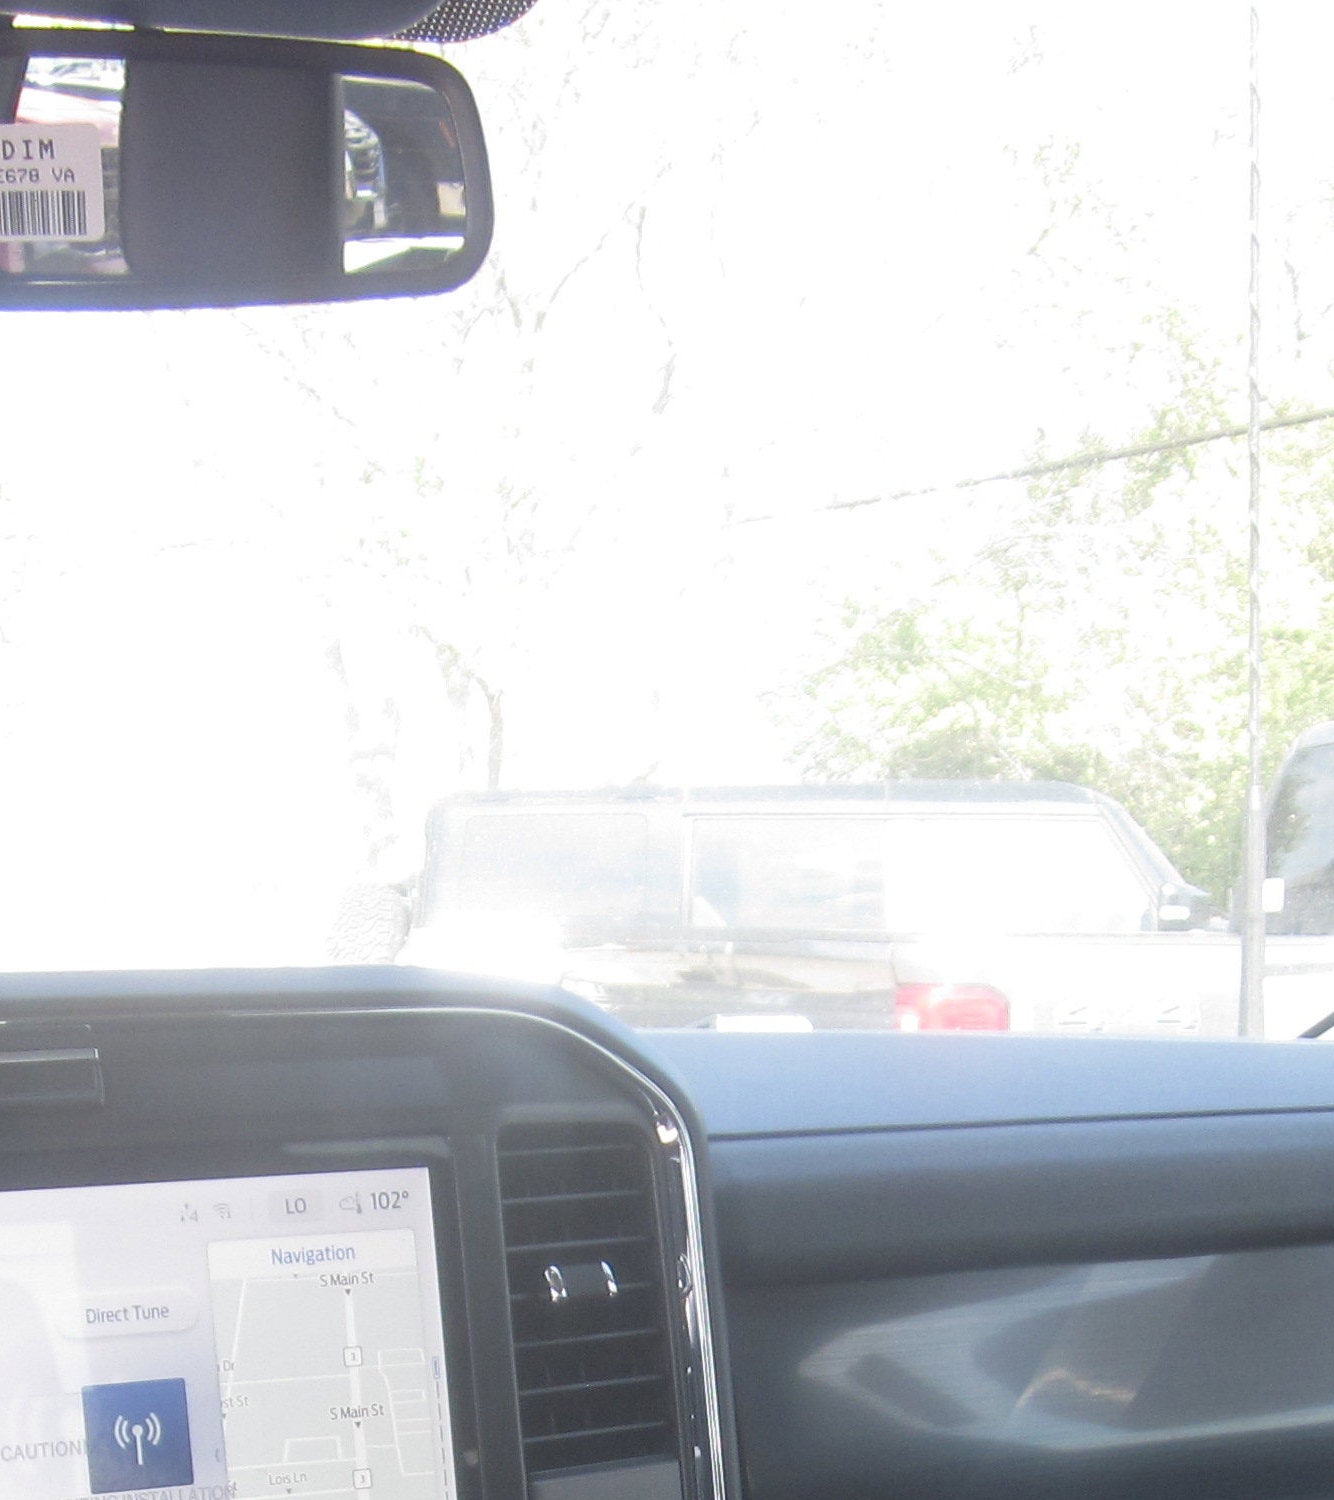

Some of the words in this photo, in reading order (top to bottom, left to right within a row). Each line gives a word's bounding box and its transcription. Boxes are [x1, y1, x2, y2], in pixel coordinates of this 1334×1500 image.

[52, 167, 75, 183] VA
[285, 1197, 307, 1215] LO
[370, 1190, 409, 1211] 102°
[271, 1244, 356, 1267] Navigation
[320, 1275, 328, 1287] S
[330, 1272, 360, 1287] Main
[363, 1271, 375, 1284] St
[86, 1306, 129, 1325] Direct
[134, 1304, 169, 1322] Tune
[329, 1408, 338, 1420] S
[339, 1405, 370, 1420] Main
[372, 1404, 385, 1417] St
[269, 1473, 291, 1486] Lois
[294, 1471, 307, 1484] Ln
